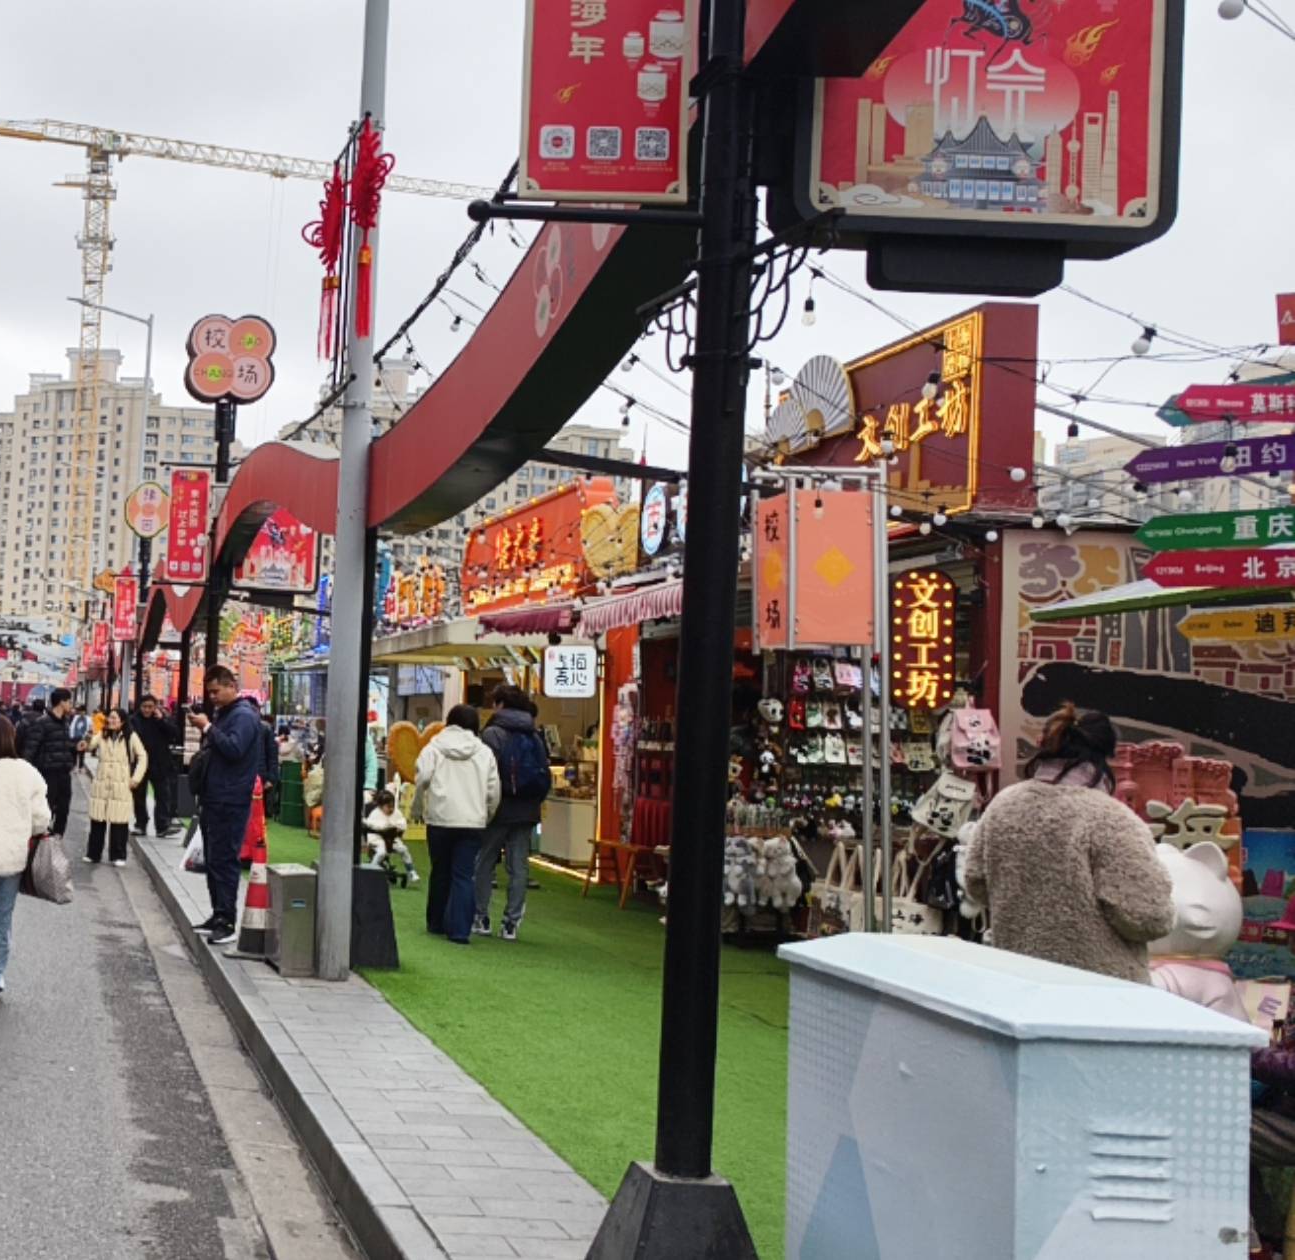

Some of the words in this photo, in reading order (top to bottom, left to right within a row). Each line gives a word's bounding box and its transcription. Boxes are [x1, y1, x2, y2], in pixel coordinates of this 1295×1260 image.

[205, 328, 226, 348] 校
[237, 364, 258, 385] 场
[854, 380, 970, 462] 文创工坊
[764, 510, 782, 543] 校
[1232, 512, 1295, 541] 重庆
[1194, 563, 1225, 575] Beijing
[1240, 555, 1295, 580] 北京
[906, 577, 940, 703] 文创工坊
